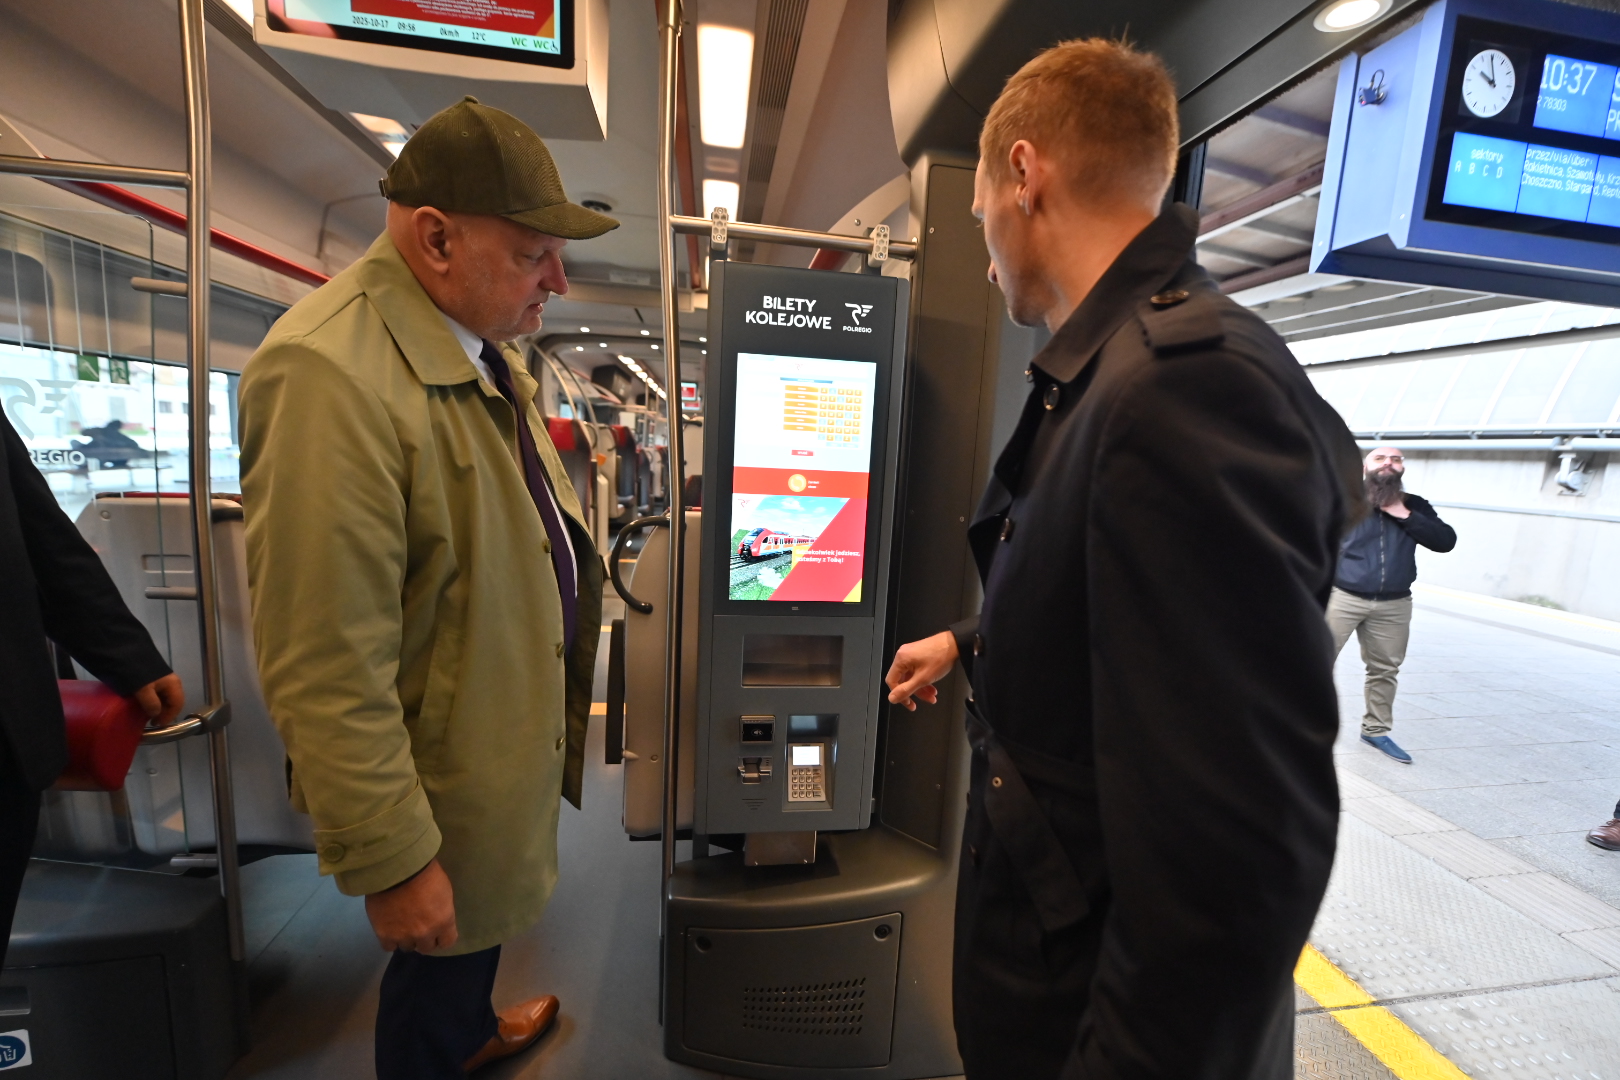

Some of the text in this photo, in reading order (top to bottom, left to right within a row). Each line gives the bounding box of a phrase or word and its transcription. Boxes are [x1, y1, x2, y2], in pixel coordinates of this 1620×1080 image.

[352, 15, 389, 28] 2025-10-17
[439, 27, 460, 38] 0km/h
[472, 31, 487, 42] 12°C
[511, 36, 528, 47] WC
[533, 39, 550, 50] WC
[1540, 57, 1598, 96] 10:37
[1543, 96, 1568, 112] 78303
[1455, 160, 1504, 179] A B C D
[1524, 159, 1565, 178] Rokietnica,
[1521, 172, 1564, 191] Choszczno,
[763, 295, 817, 313] BILETY
[745, 310, 832, 330] KOLEJOWE
[842, 325, 873, 334] POLREGIO
